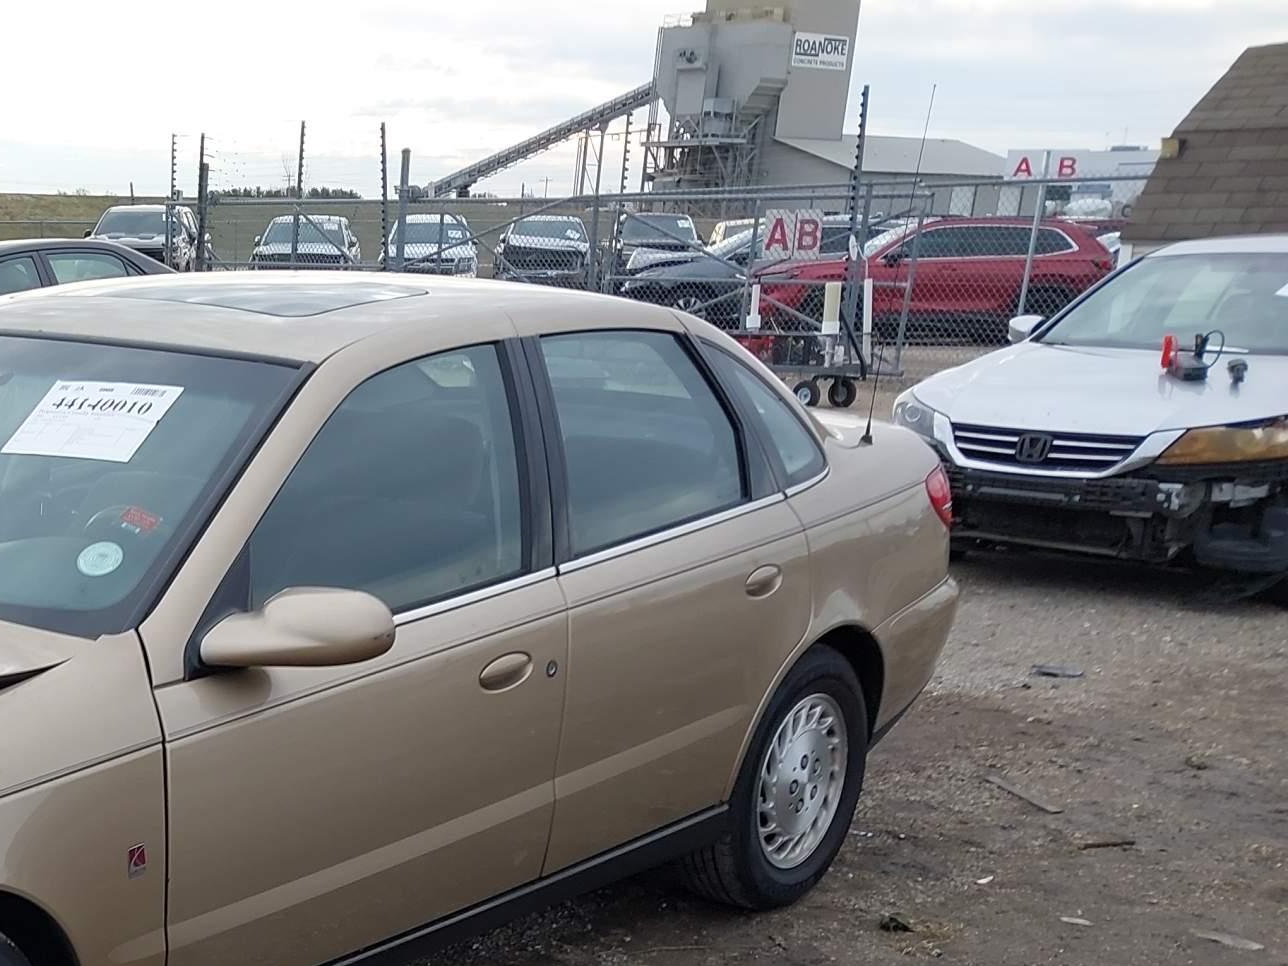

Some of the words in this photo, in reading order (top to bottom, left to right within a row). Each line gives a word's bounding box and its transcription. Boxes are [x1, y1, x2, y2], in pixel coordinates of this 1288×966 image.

[795, 37, 847, 56] ROANOKE
[1014, 157, 1032, 177] A
[1058, 157, 1077, 177] B
[765, 218, 789, 251] A
[797, 218, 819, 251] B
[52, 397, 153, 415] 44140010
